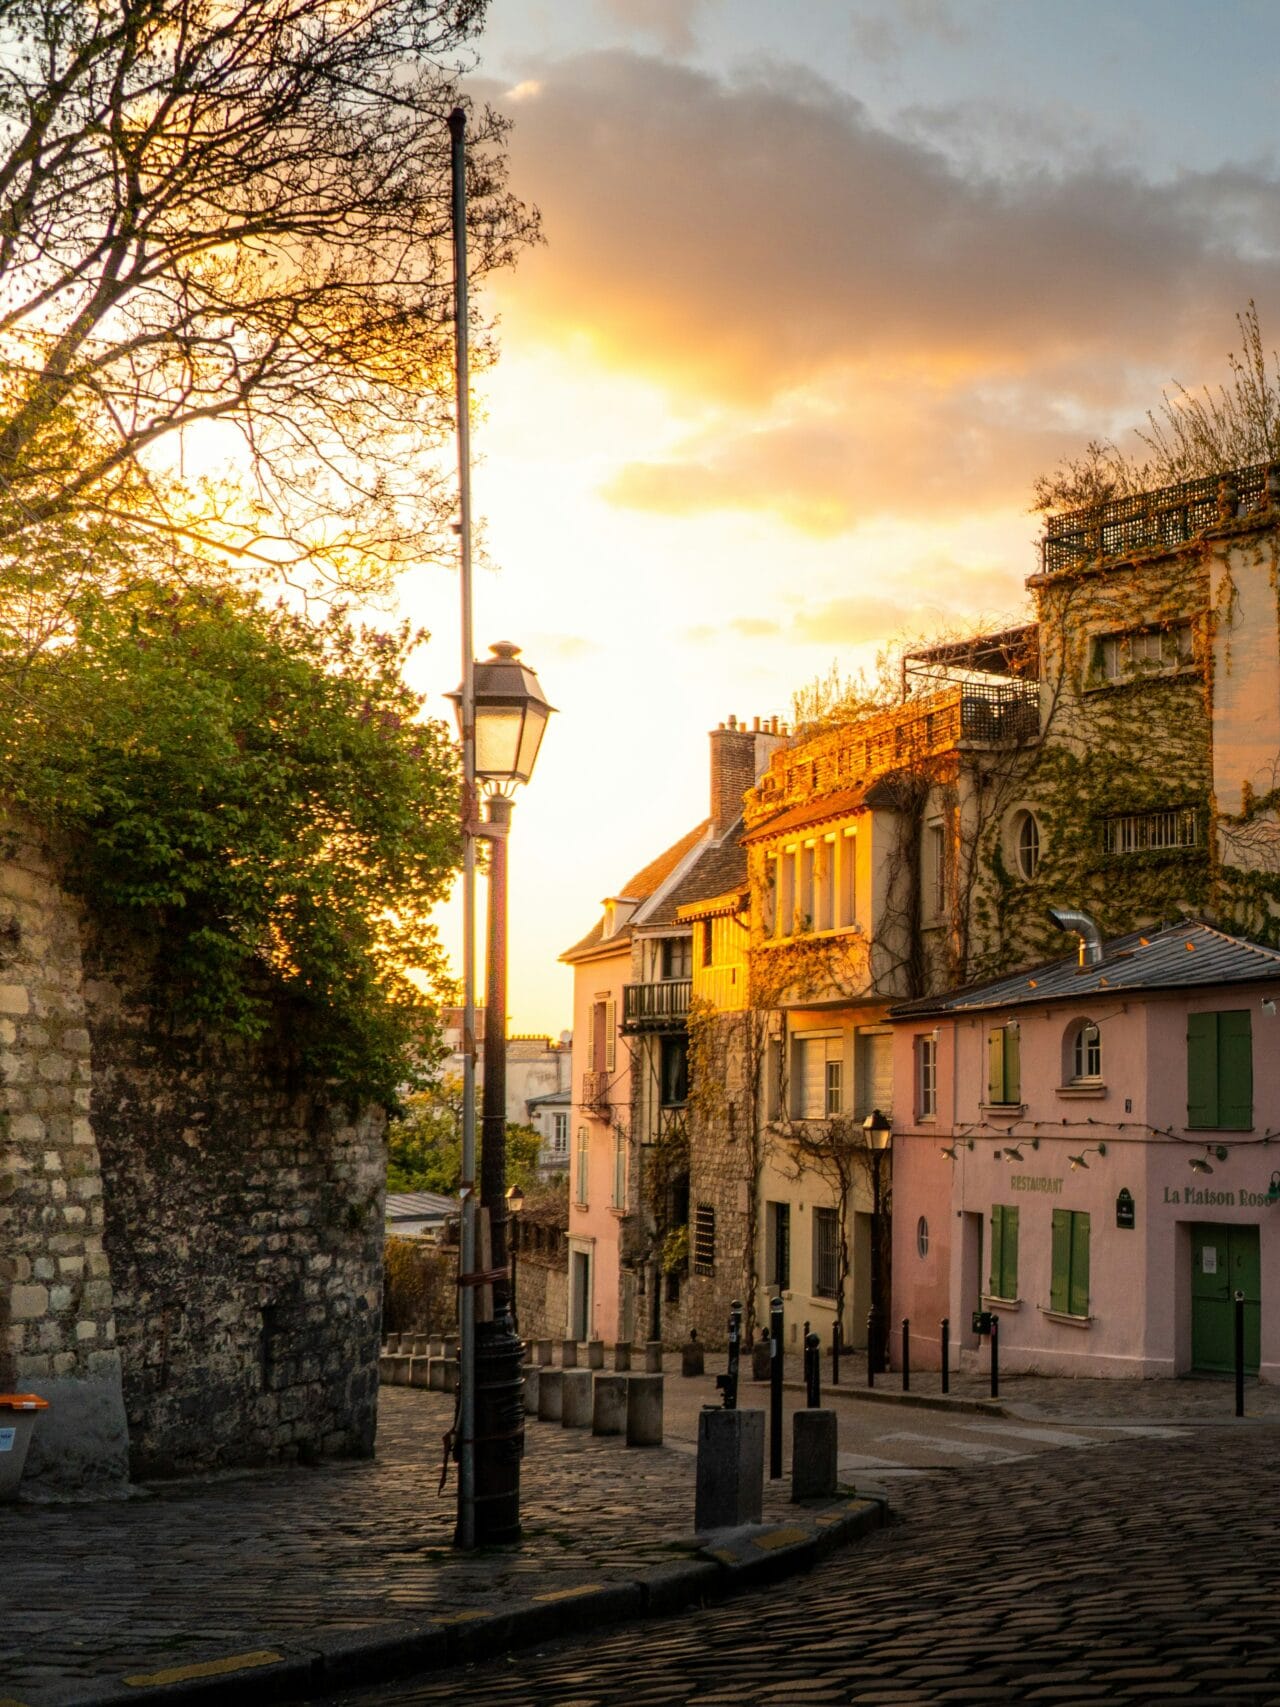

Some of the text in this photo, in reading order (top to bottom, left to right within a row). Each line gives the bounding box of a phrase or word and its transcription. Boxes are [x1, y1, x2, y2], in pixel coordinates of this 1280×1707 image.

[1011, 1176, 1064, 1194] RESTAURANT
[1163, 1187, 1180, 1204] La
[1184, 1187, 1235, 1206] Maison
